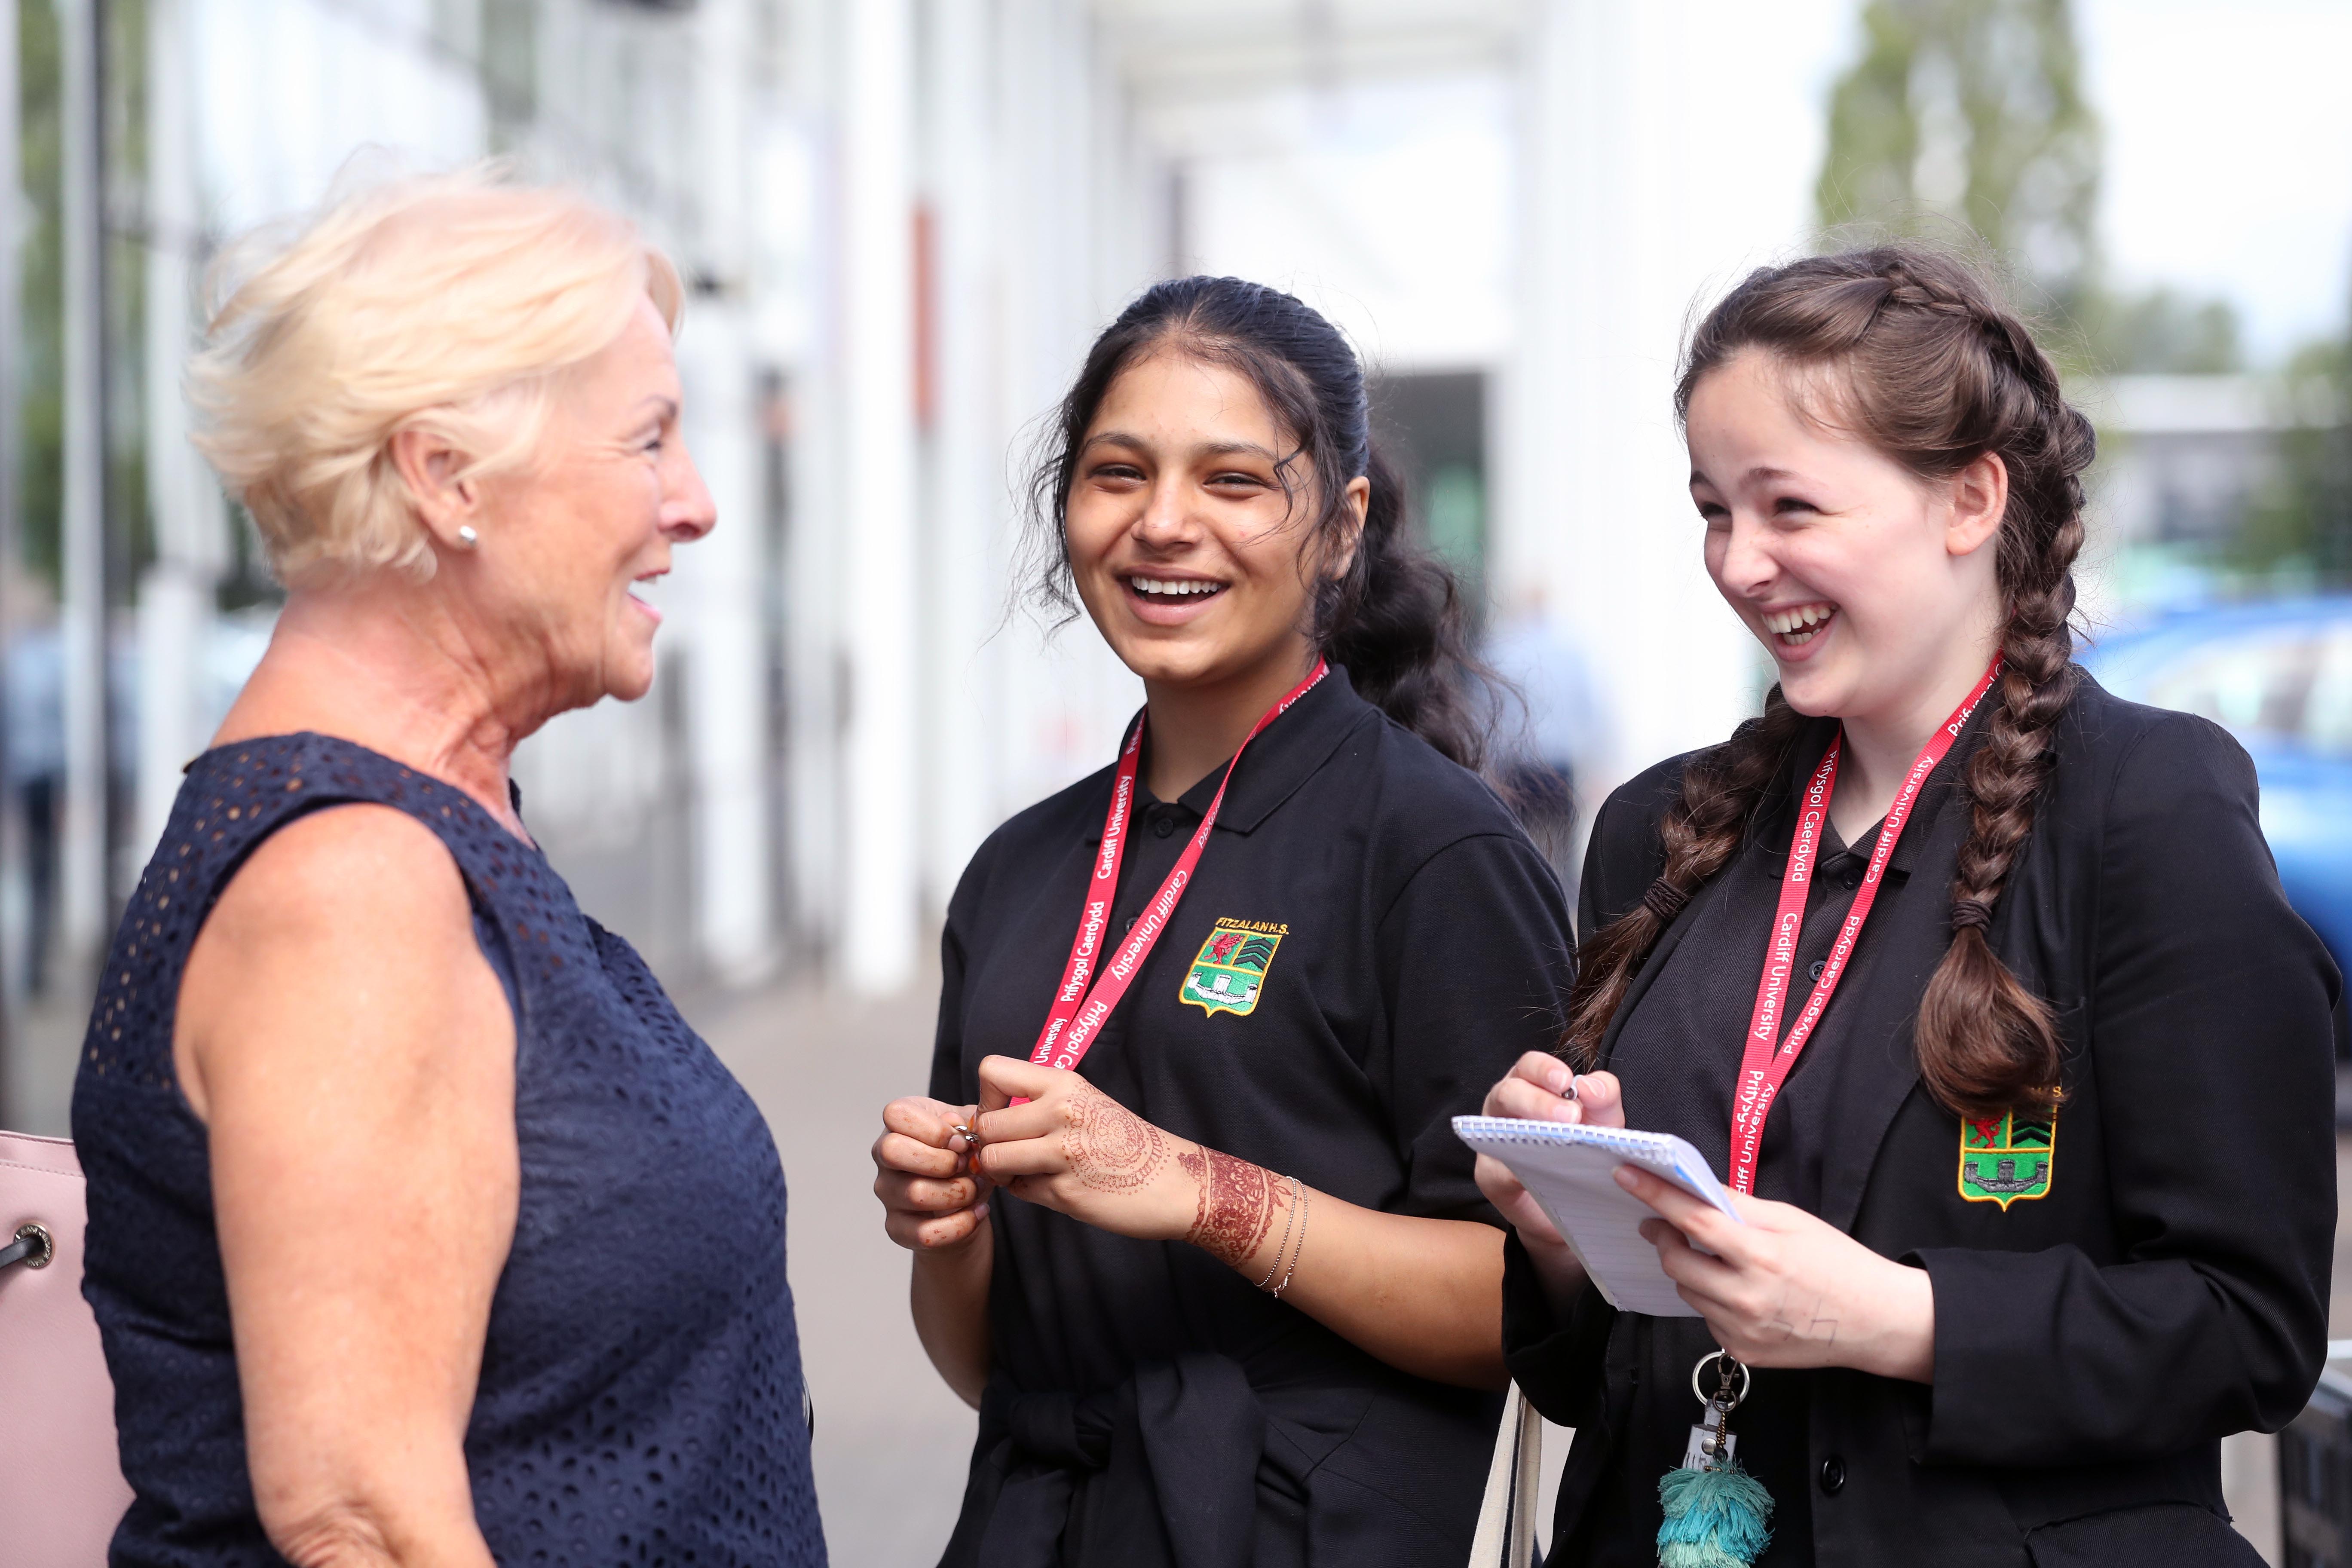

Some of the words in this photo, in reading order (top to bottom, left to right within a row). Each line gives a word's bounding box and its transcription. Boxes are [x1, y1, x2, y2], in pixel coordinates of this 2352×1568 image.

[1107, 775, 1133, 838] University
[1808, 750, 1837, 808] Prifysgol
[1792, 811, 1820, 882] Caerdydd
[1867, 830, 1893, 883] Cardiff
[1891, 756, 1934, 828] University
[1097, 838, 1118, 879] Cardiff
[1156, 870, 1188, 919] Cardiff
[1060, 958, 1089, 1001] Prifysgol
[1077, 901, 1105, 957] Caerdydd
[1111, 914, 1162, 980] University
[1774, 913, 1798, 963] Cardiff
[1754, 966, 1786, 1041] University
[1783, 992, 1825, 1054] Prifysgol
[1820, 916, 1860, 989] Caerdydd
[1033, 1018, 1068, 1063] University
[1065, 1000, 1108, 1055] Prifysgol
[1741, 1083, 1774, 1164] University
[1735, 1165, 1750, 1194] diff
